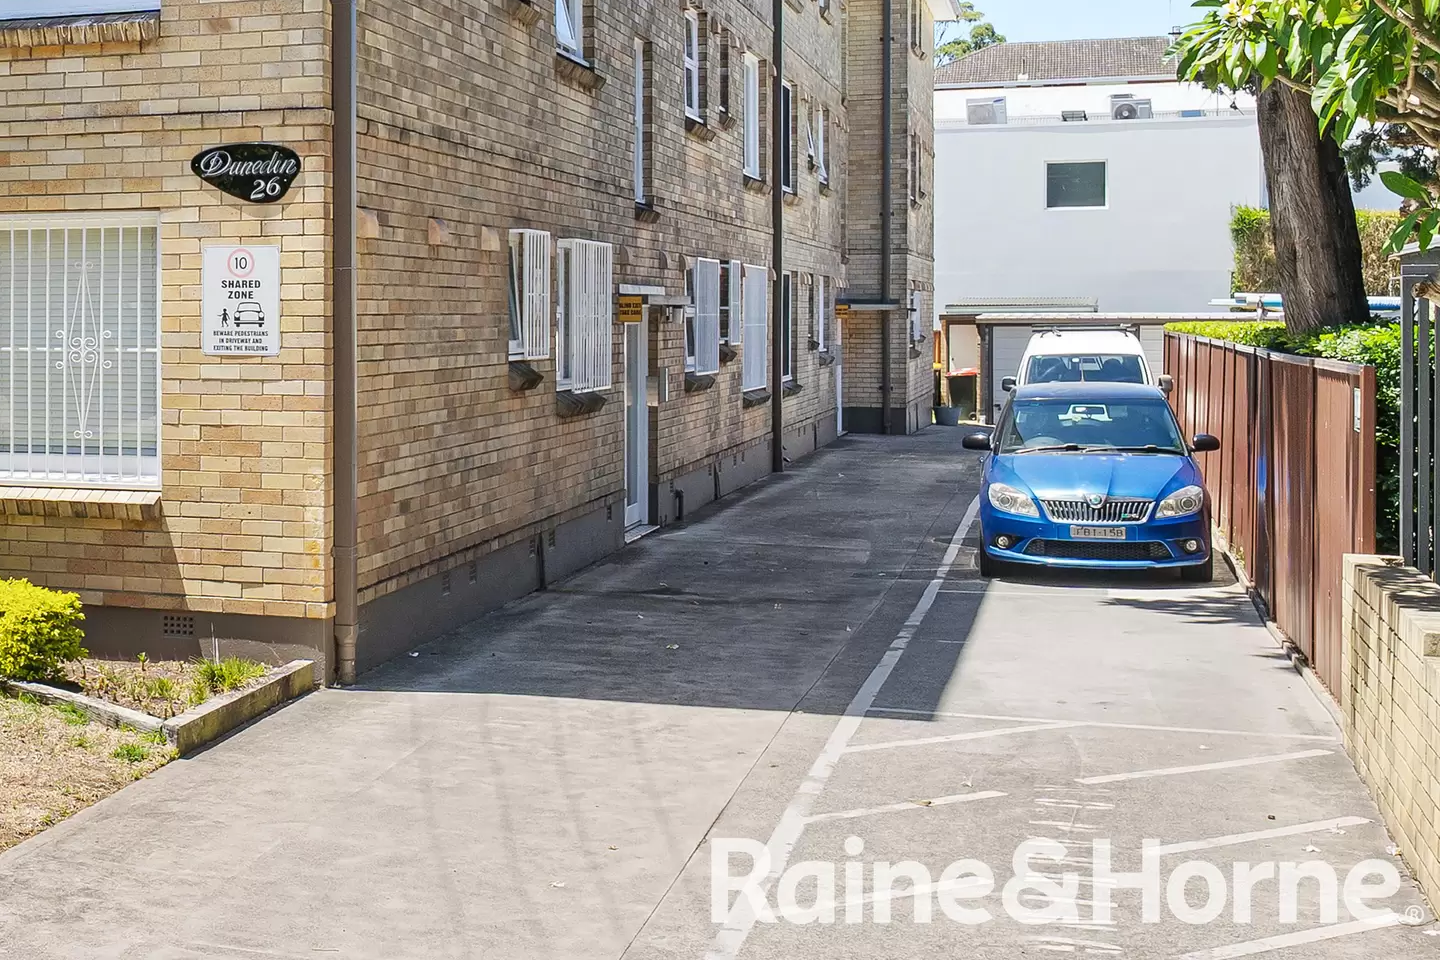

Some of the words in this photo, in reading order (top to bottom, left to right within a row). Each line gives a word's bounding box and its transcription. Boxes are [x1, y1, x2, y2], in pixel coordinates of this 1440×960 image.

[200, 150, 297, 178] Dunedin
[250, 176, 281, 200] 26
[234, 256, 248, 270] 10
[221, 279, 261, 289] SHARED
[227, 290, 254, 300] ZONE
